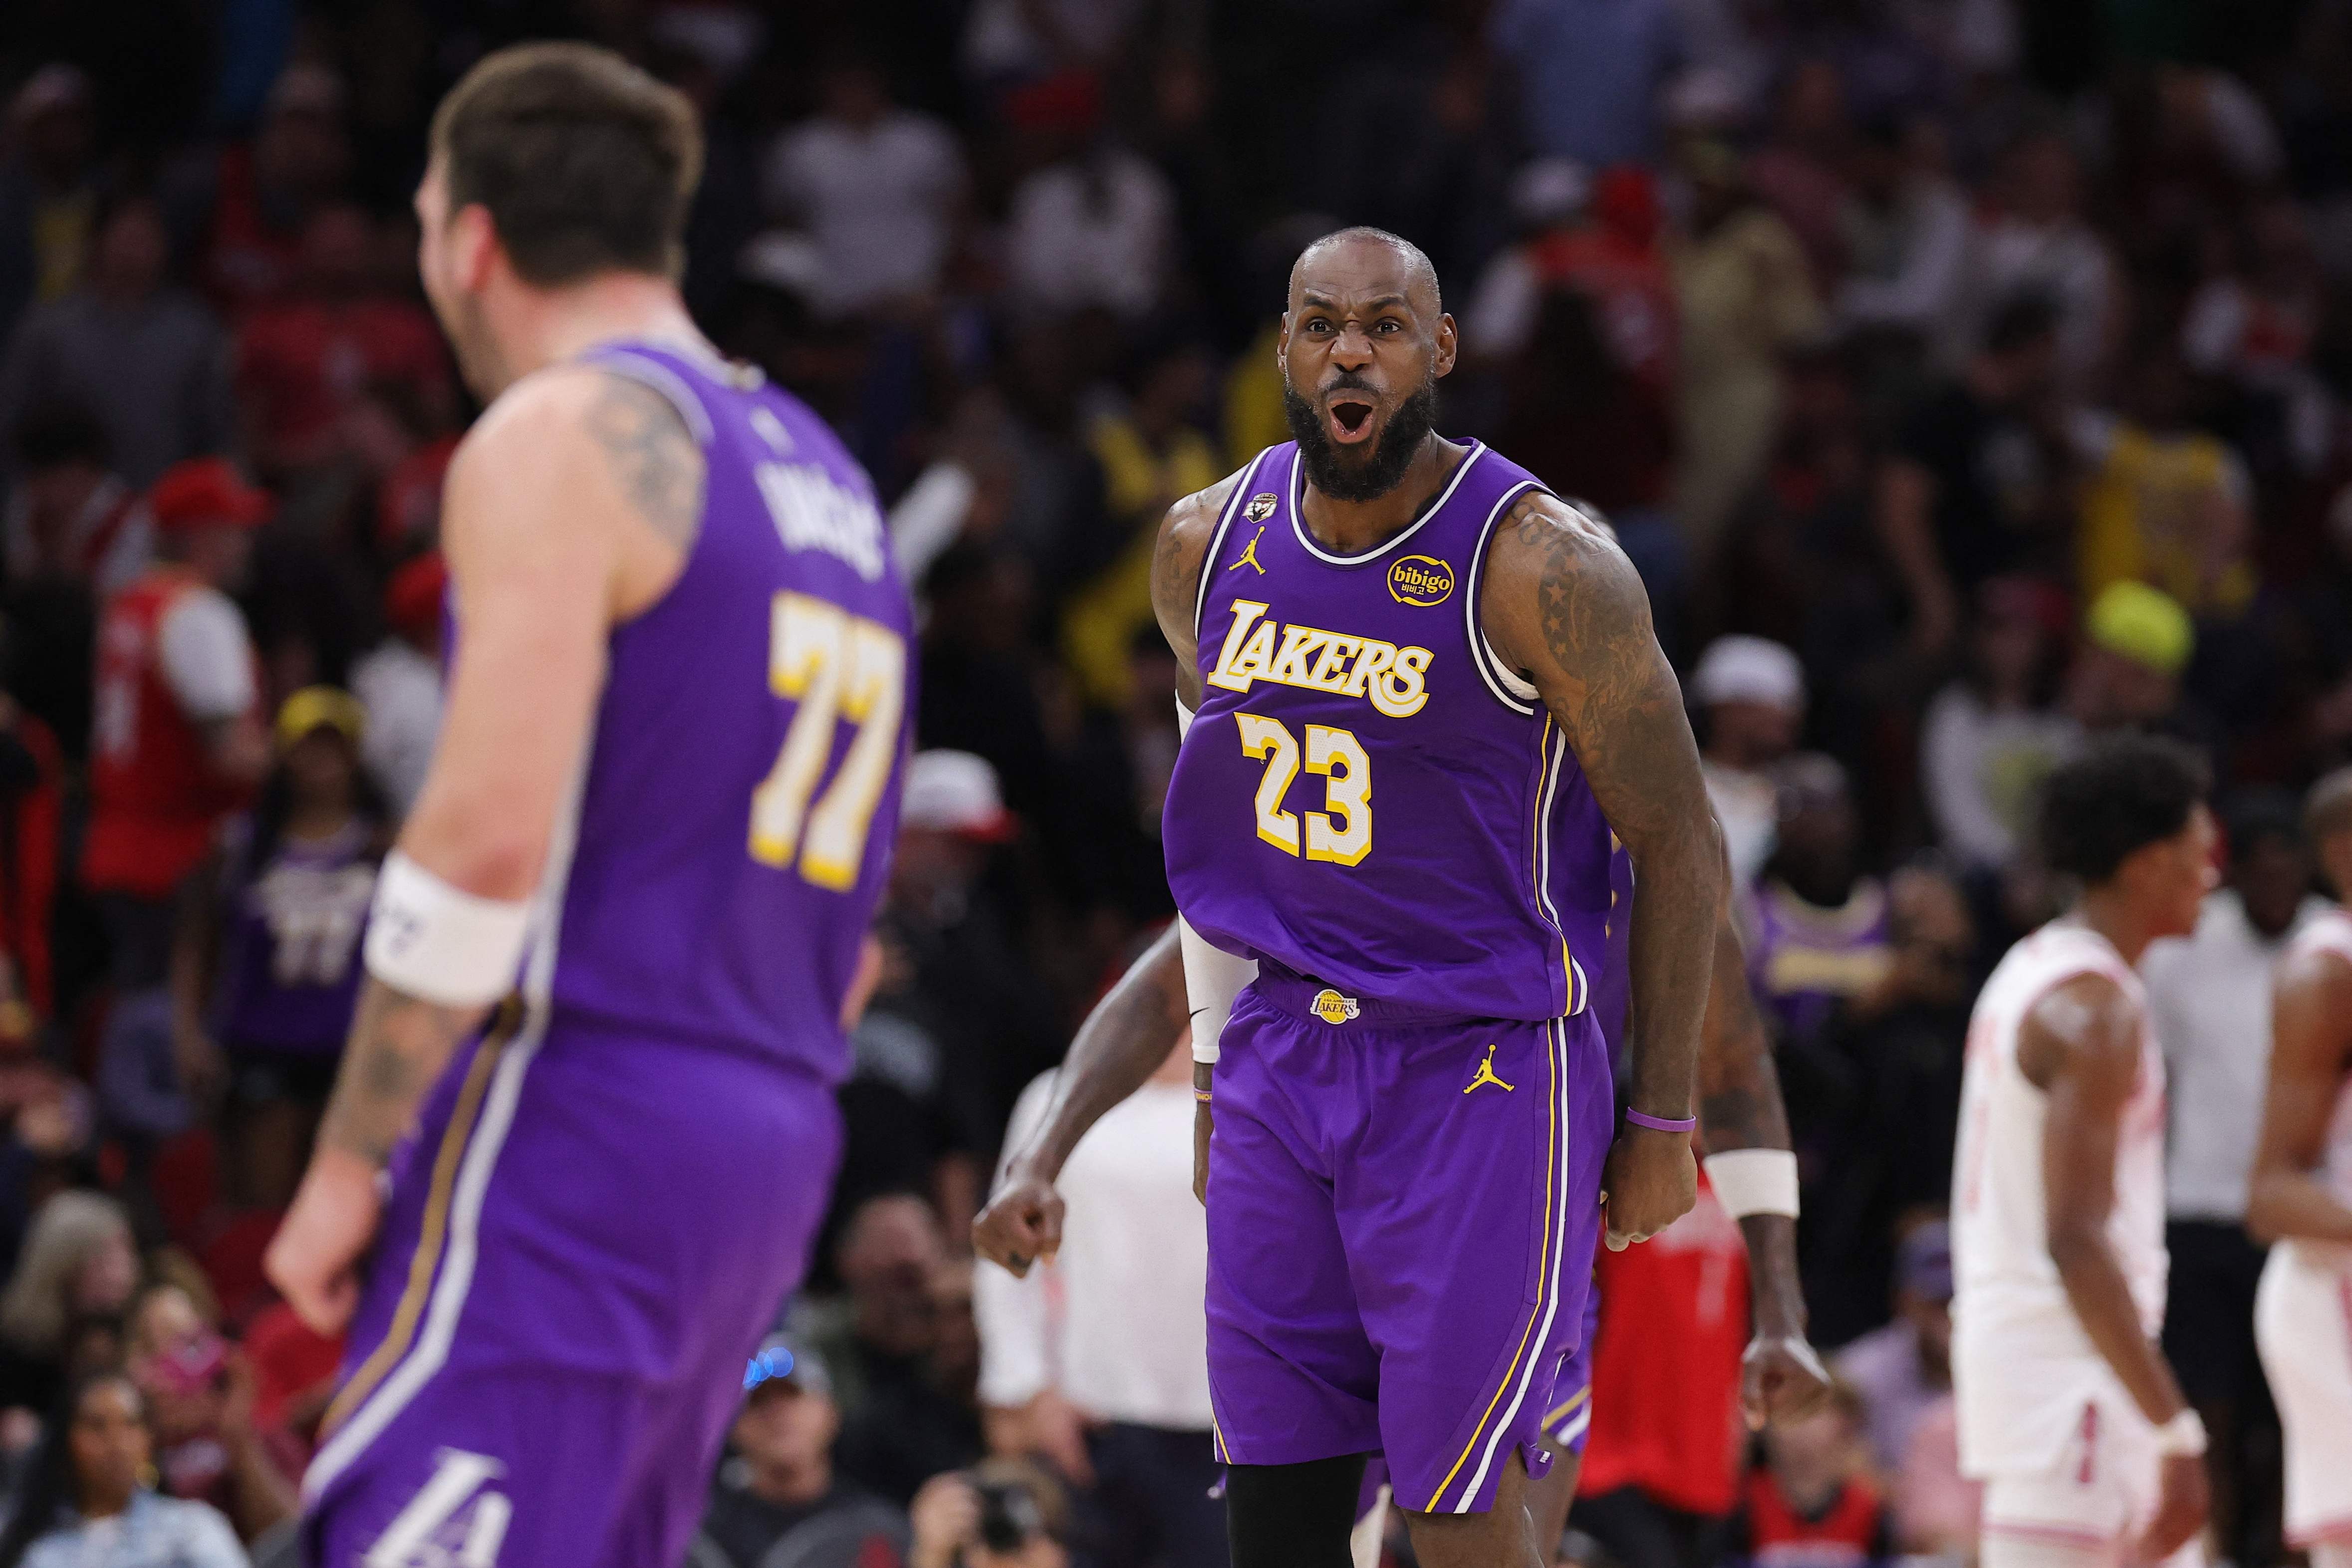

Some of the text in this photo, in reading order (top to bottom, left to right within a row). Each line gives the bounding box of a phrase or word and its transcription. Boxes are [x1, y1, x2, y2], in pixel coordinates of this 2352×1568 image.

[1393, 565, 1450, 594] bibigo
[1401, 583, 1425, 595] 비비고
[1207, 598, 1435, 718] LAKERS
[748, 588, 906, 893] 77
[1233, 711, 1372, 867] 23
[1313, 997, 1359, 1018] LAKERS
